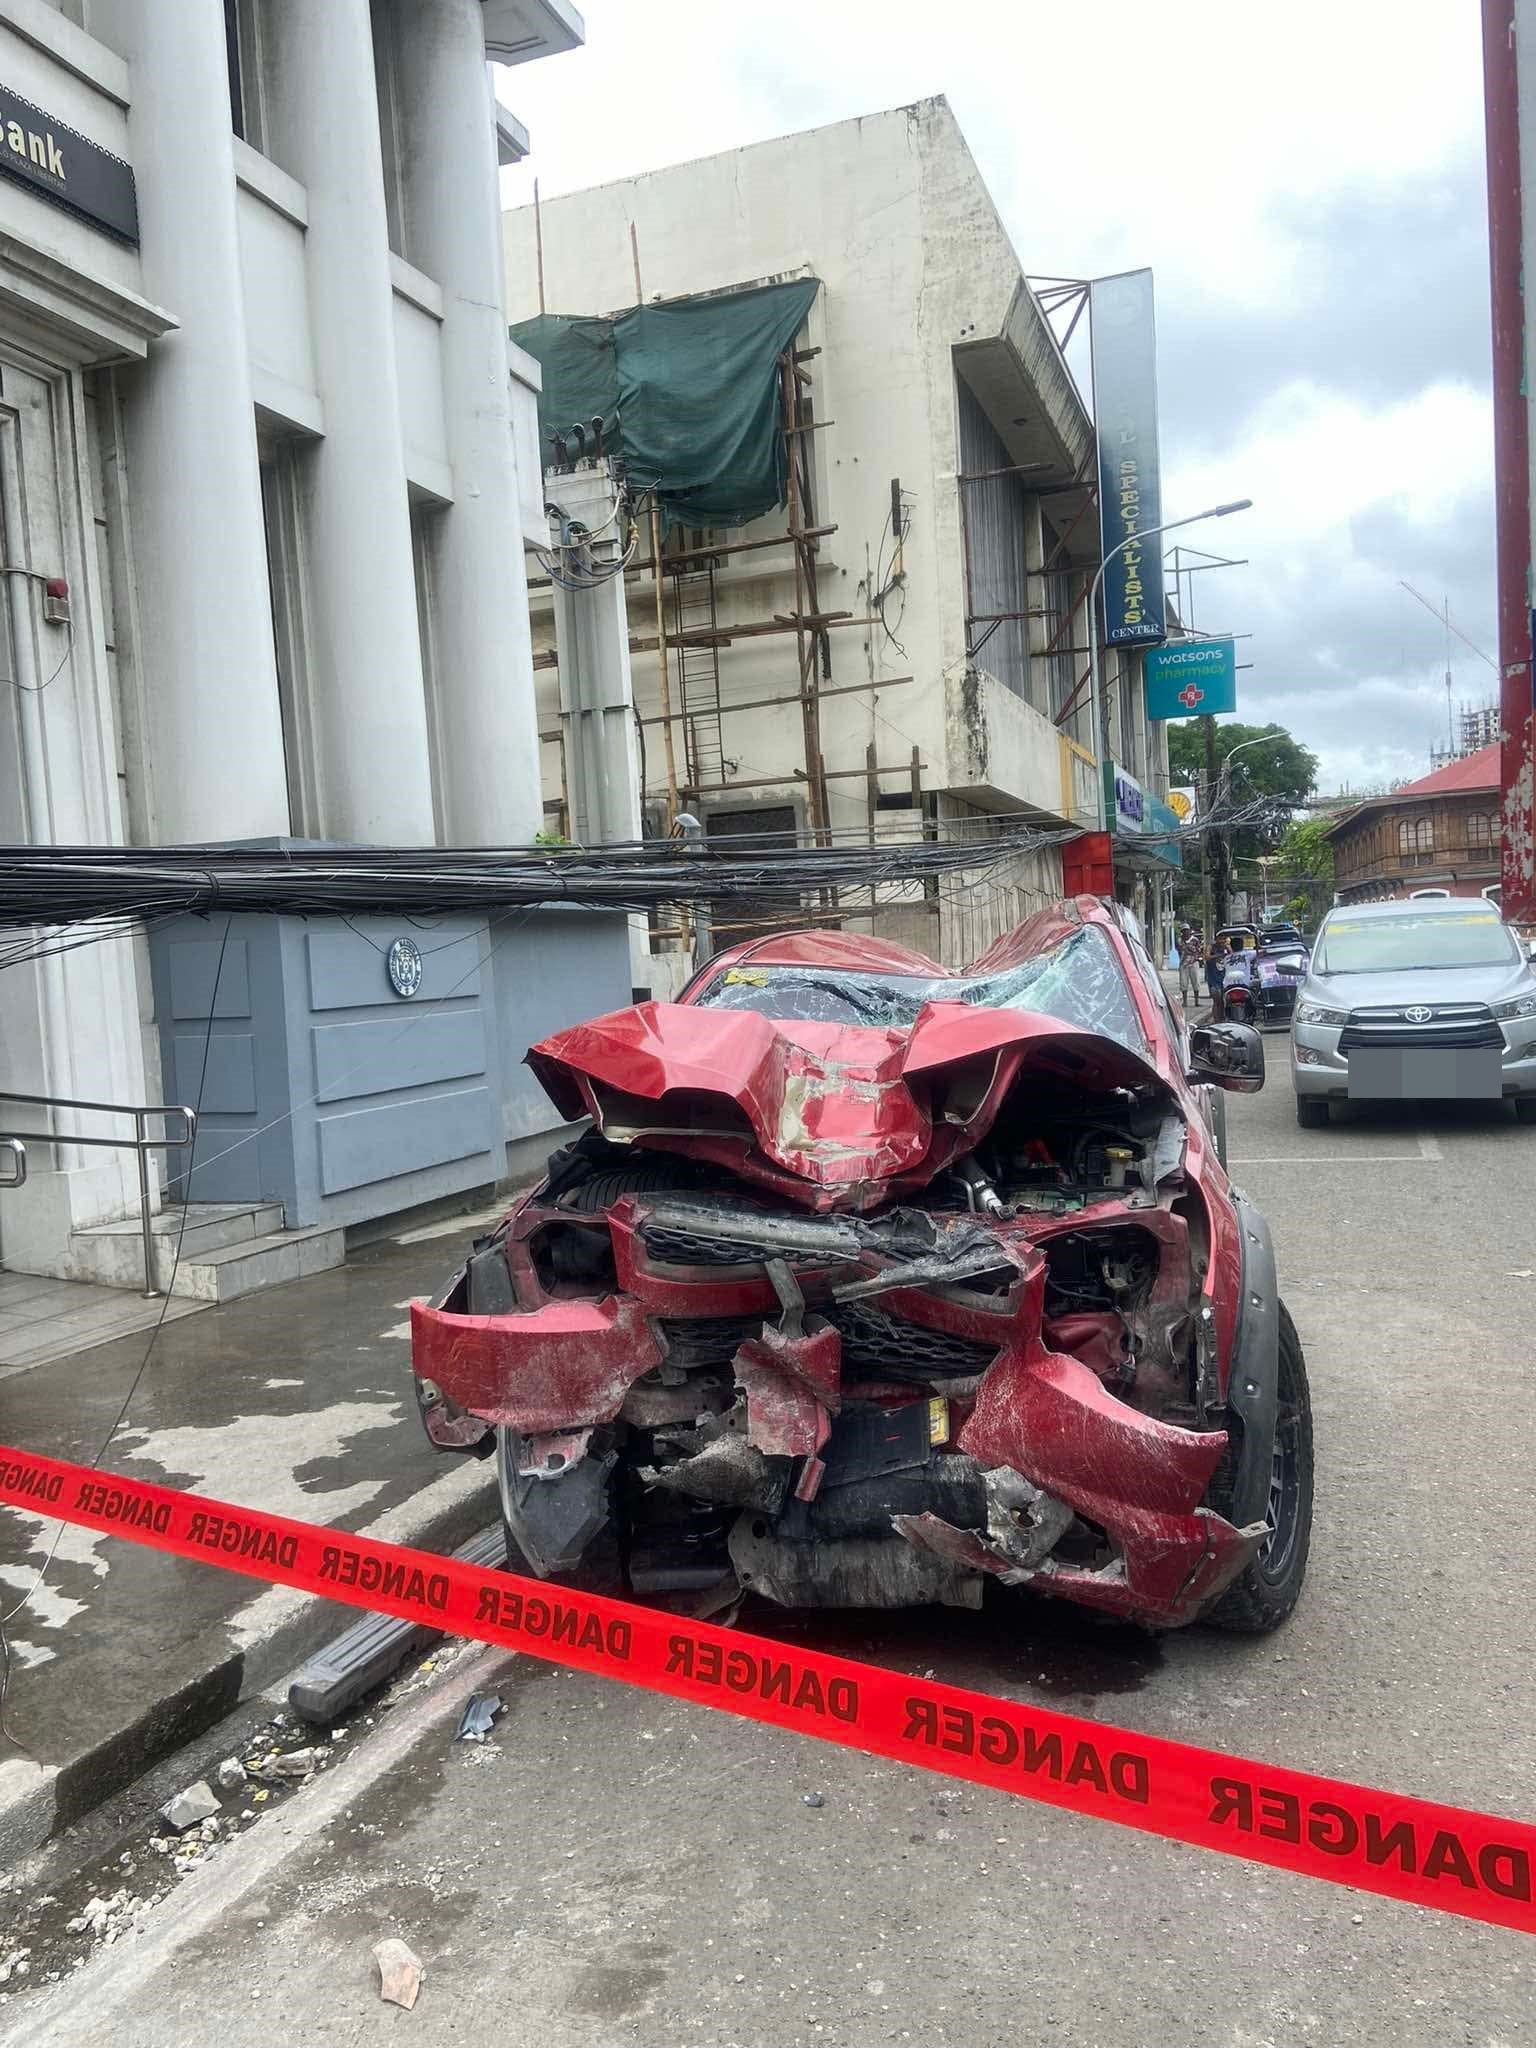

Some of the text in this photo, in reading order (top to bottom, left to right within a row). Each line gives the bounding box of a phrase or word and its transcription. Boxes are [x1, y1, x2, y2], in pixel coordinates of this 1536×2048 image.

[1112, 623, 1160, 639] CENTER
[1159, 649, 1224, 665] watsons
[1154, 663, 1226, 682] pharmacy
